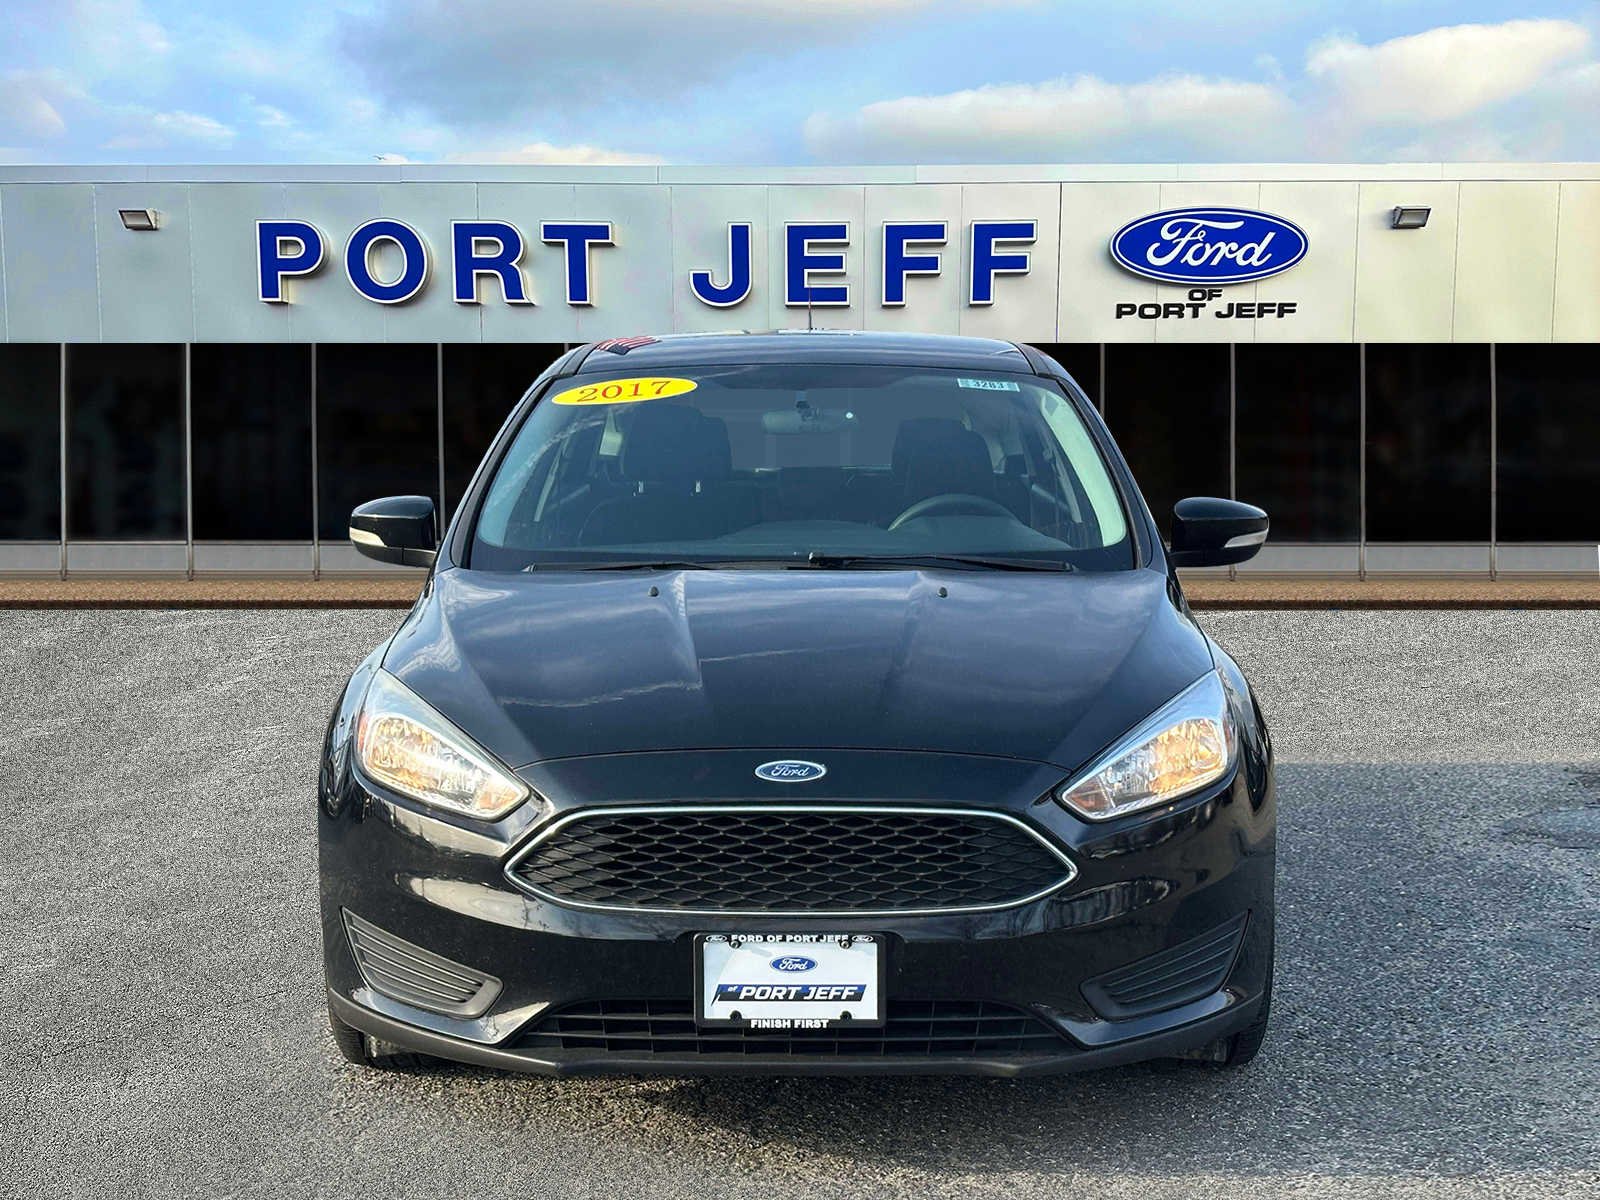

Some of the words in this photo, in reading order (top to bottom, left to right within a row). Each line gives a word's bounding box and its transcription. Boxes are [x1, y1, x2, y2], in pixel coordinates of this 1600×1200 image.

[1146, 218, 1276, 266] Ford
[255, 219, 614, 304] PORT
[689, 220, 1037, 307] JEFF
[1188, 288, 1222, 301] OF
[1115, 303, 1206, 319] PORT
[1215, 302, 1297, 319] JEFF
[577, 380, 671, 402] 2017
[771, 764, 810, 776] Ford
[731, 934, 763, 942] FORD
[766, 934, 783, 942] OF
[786, 934, 818, 942] PORT
[820, 934, 849, 942] JEFF
[779, 958, 808, 971] Ford
[739, 986, 801, 1000] PORT
[803, 986, 858, 1000] JEFF
[750, 1019, 791, 1029] FINISH
[794, 1019, 829, 1029] FIRST
